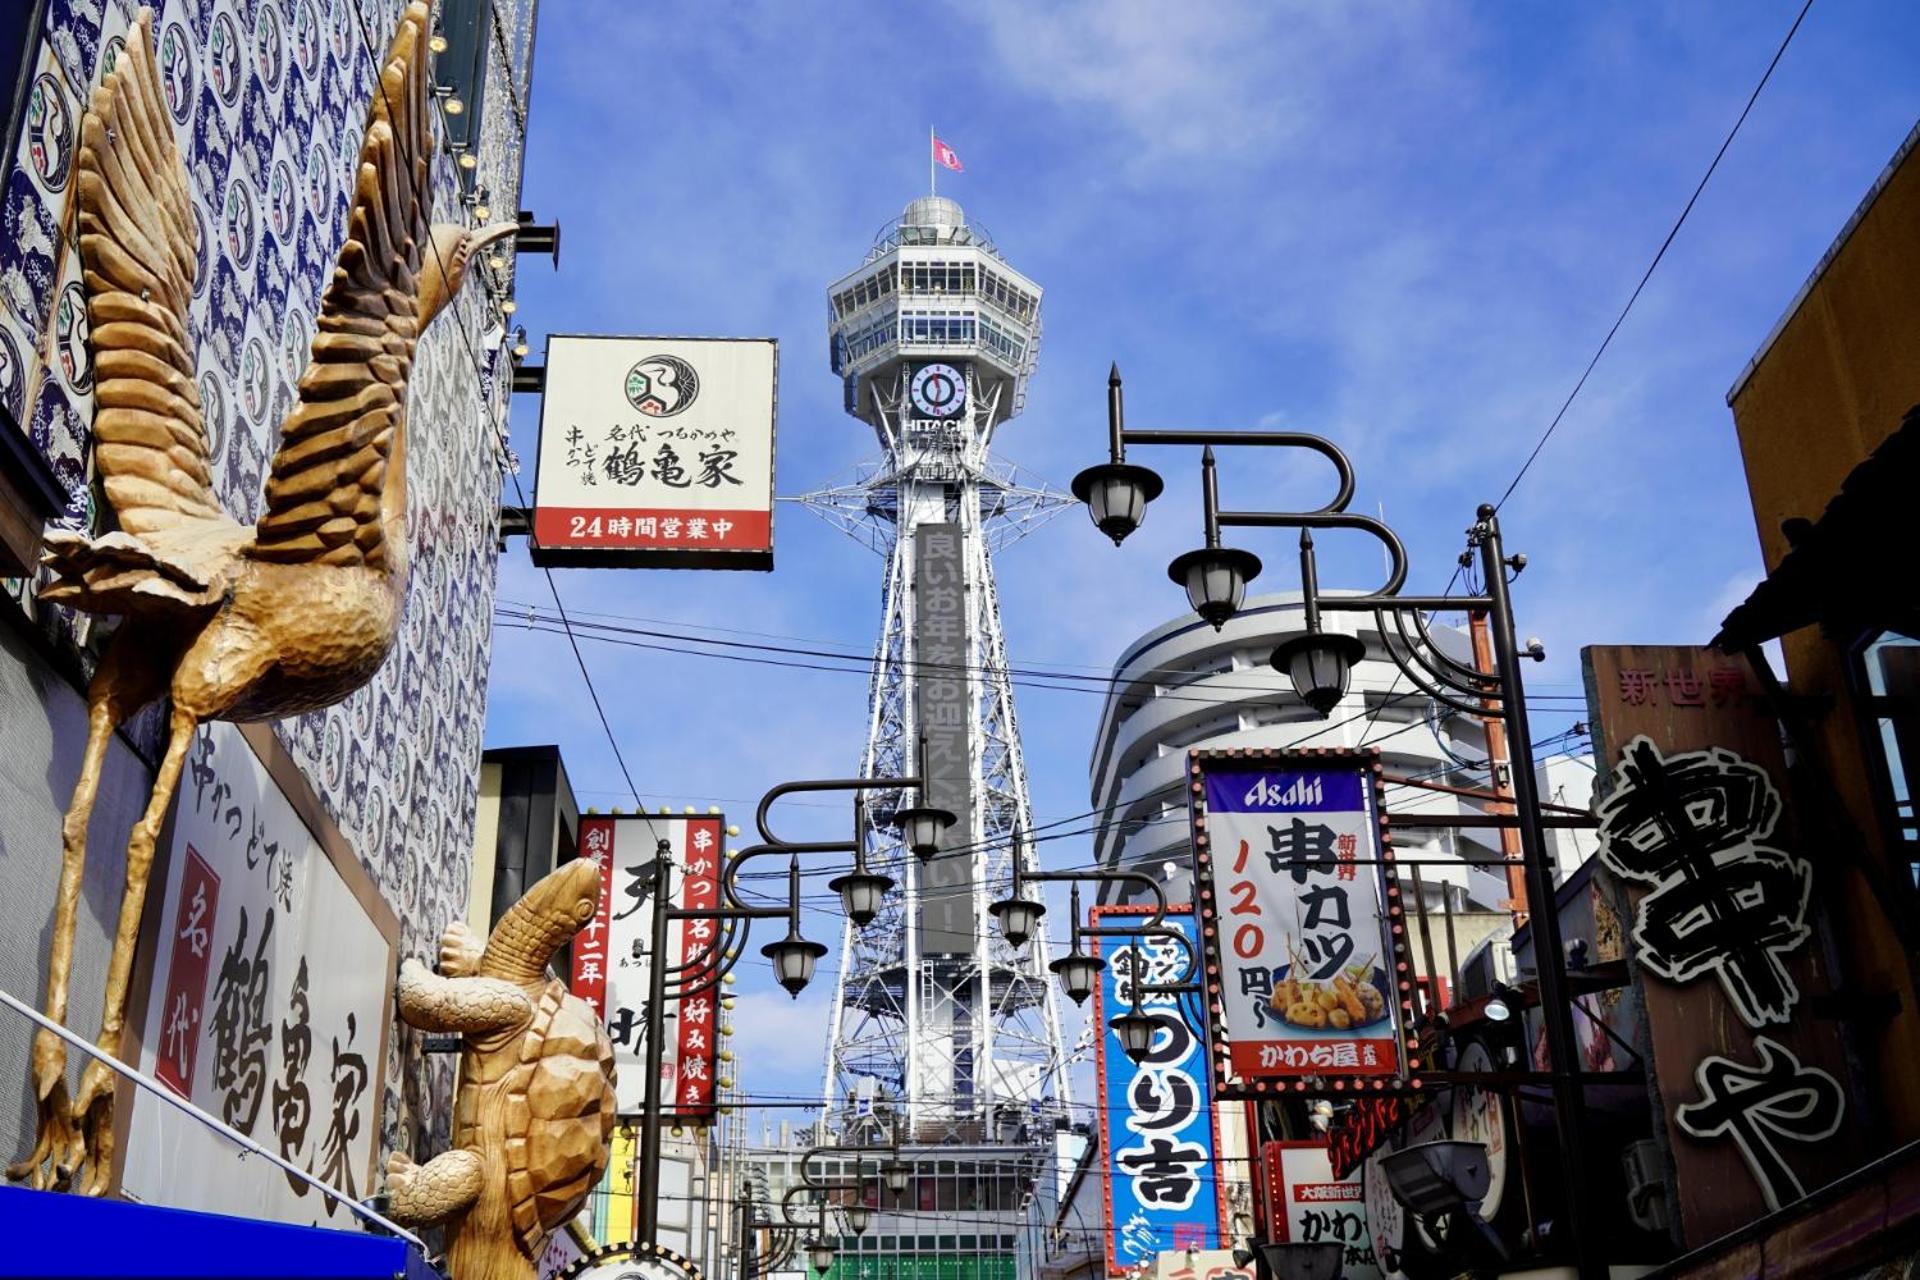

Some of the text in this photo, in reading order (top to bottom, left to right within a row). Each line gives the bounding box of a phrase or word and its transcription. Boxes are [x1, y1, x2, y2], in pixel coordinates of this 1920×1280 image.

[604, 424, 736, 442] 名代 つるかめや
[902, 419, 972, 432] HITACH
[602, 441, 744, 488] 鶴亀家
[570, 516, 734, 540] 24時間営業中
[1620, 667, 1746, 707] 新世界
[1244, 775, 1323, 808] Asahi
[1338, 833, 1356, 881] 新世界
[1266, 817, 1355, 981] 串カツ
[167, 881, 207, 1081] 名代
[209, 905, 368, 1218] 鶴亀家
[1260, 1042, 1360, 1068] かわち屋
